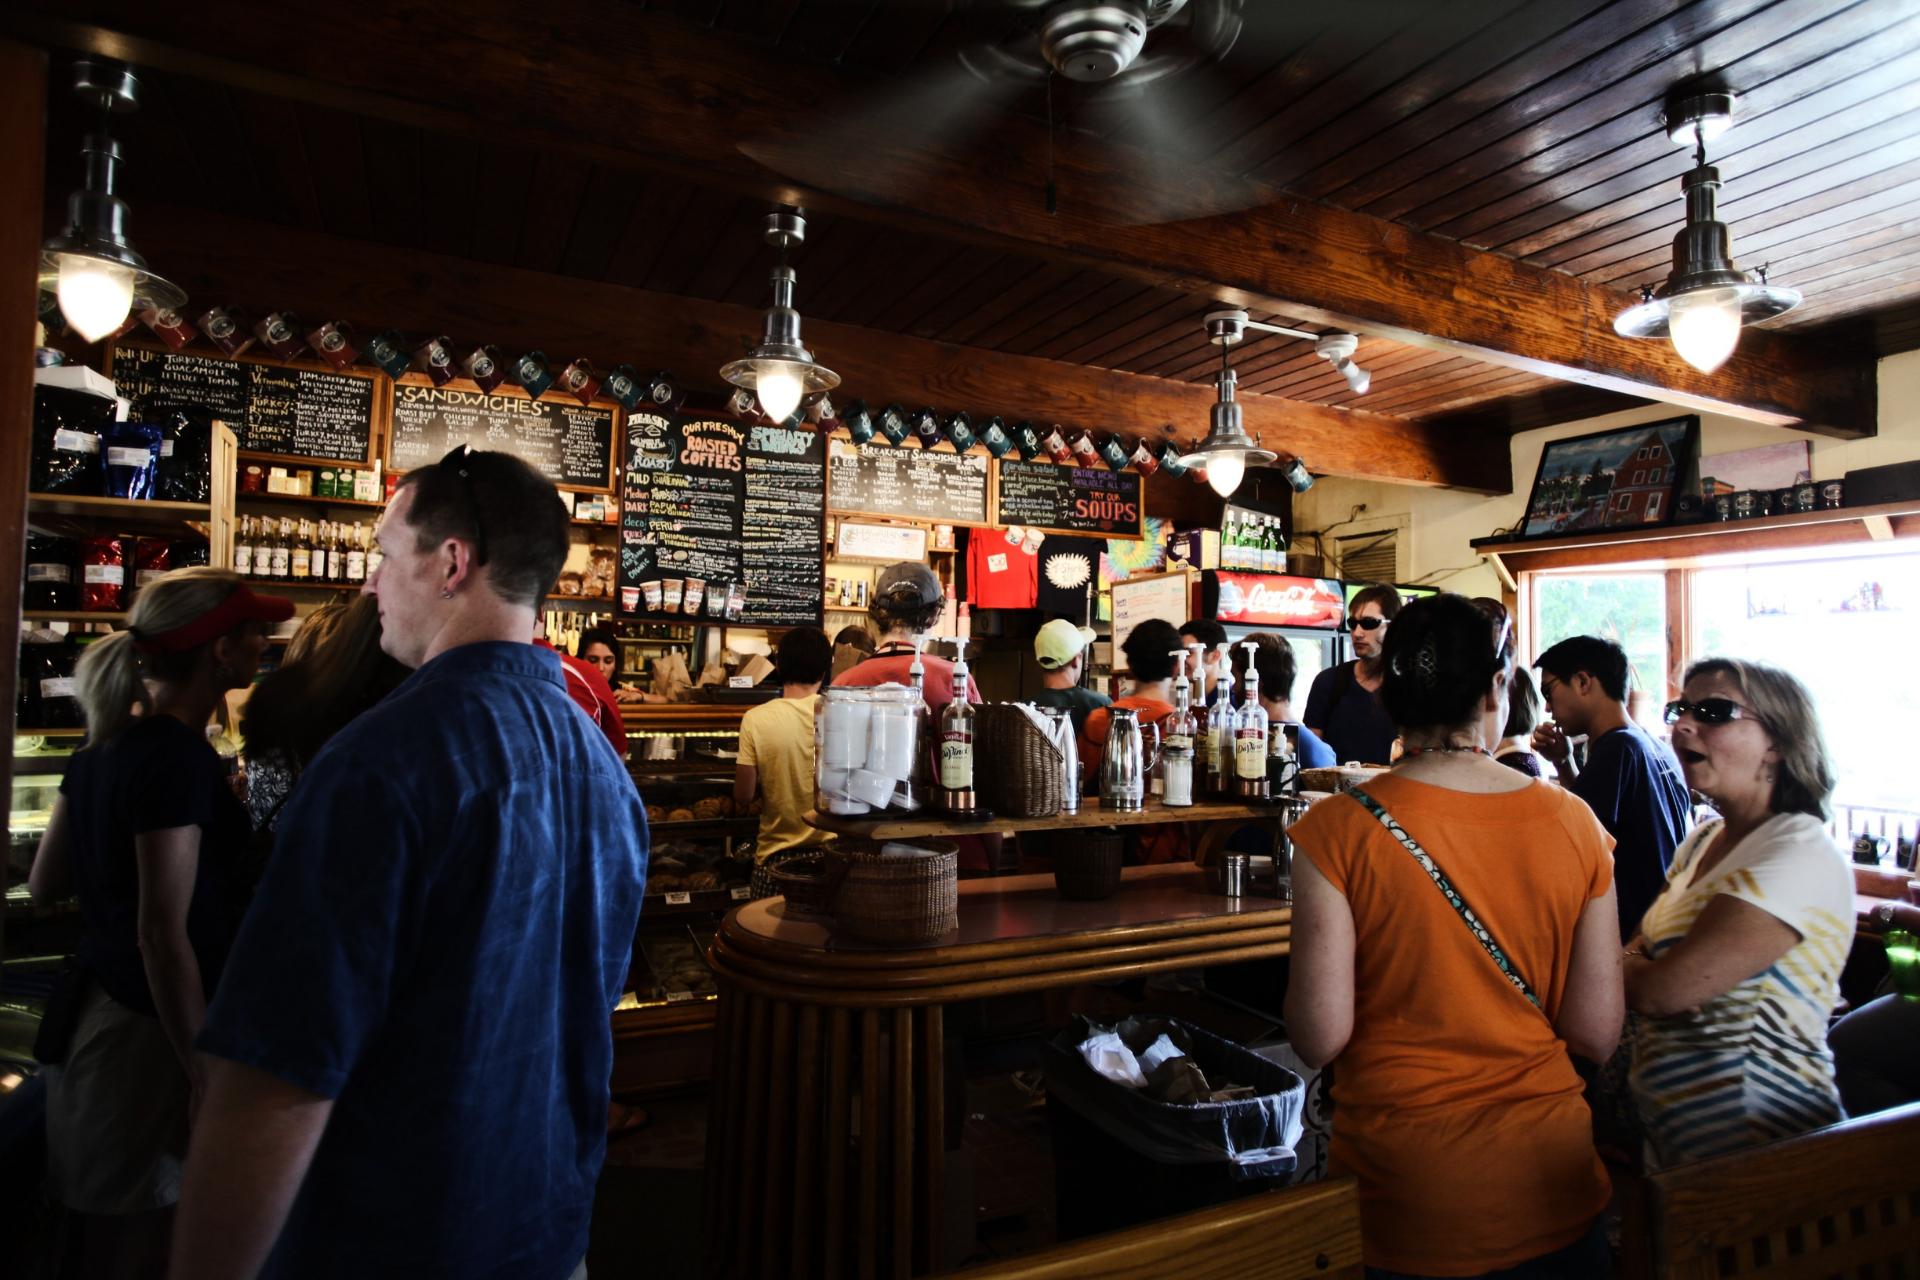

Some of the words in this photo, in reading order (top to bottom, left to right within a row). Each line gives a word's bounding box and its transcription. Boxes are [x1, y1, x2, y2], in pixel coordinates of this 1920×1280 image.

[298, 393, 329, 402] TOASTED
[331, 397, 360, 406] WHEAT
[403, 386, 542, 416] SANDWICHES
[400, 416, 430, 425] TURKEY
[443, 413, 479, 422] CHICKEN
[682, 422, 701, 436] OUR
[702, 421, 745, 445] FRESHLY
[687, 436, 737, 456] ROASTED
[861, 445, 909, 458] BREAKFAST
[911, 449, 962, 464] SANDWICHES
[681, 450, 742, 472] COFFEES
[626, 472, 650, 484] MILD
[649, 501, 677, 511] PAPUA
[1075, 499, 1137, 523] SOUPS
